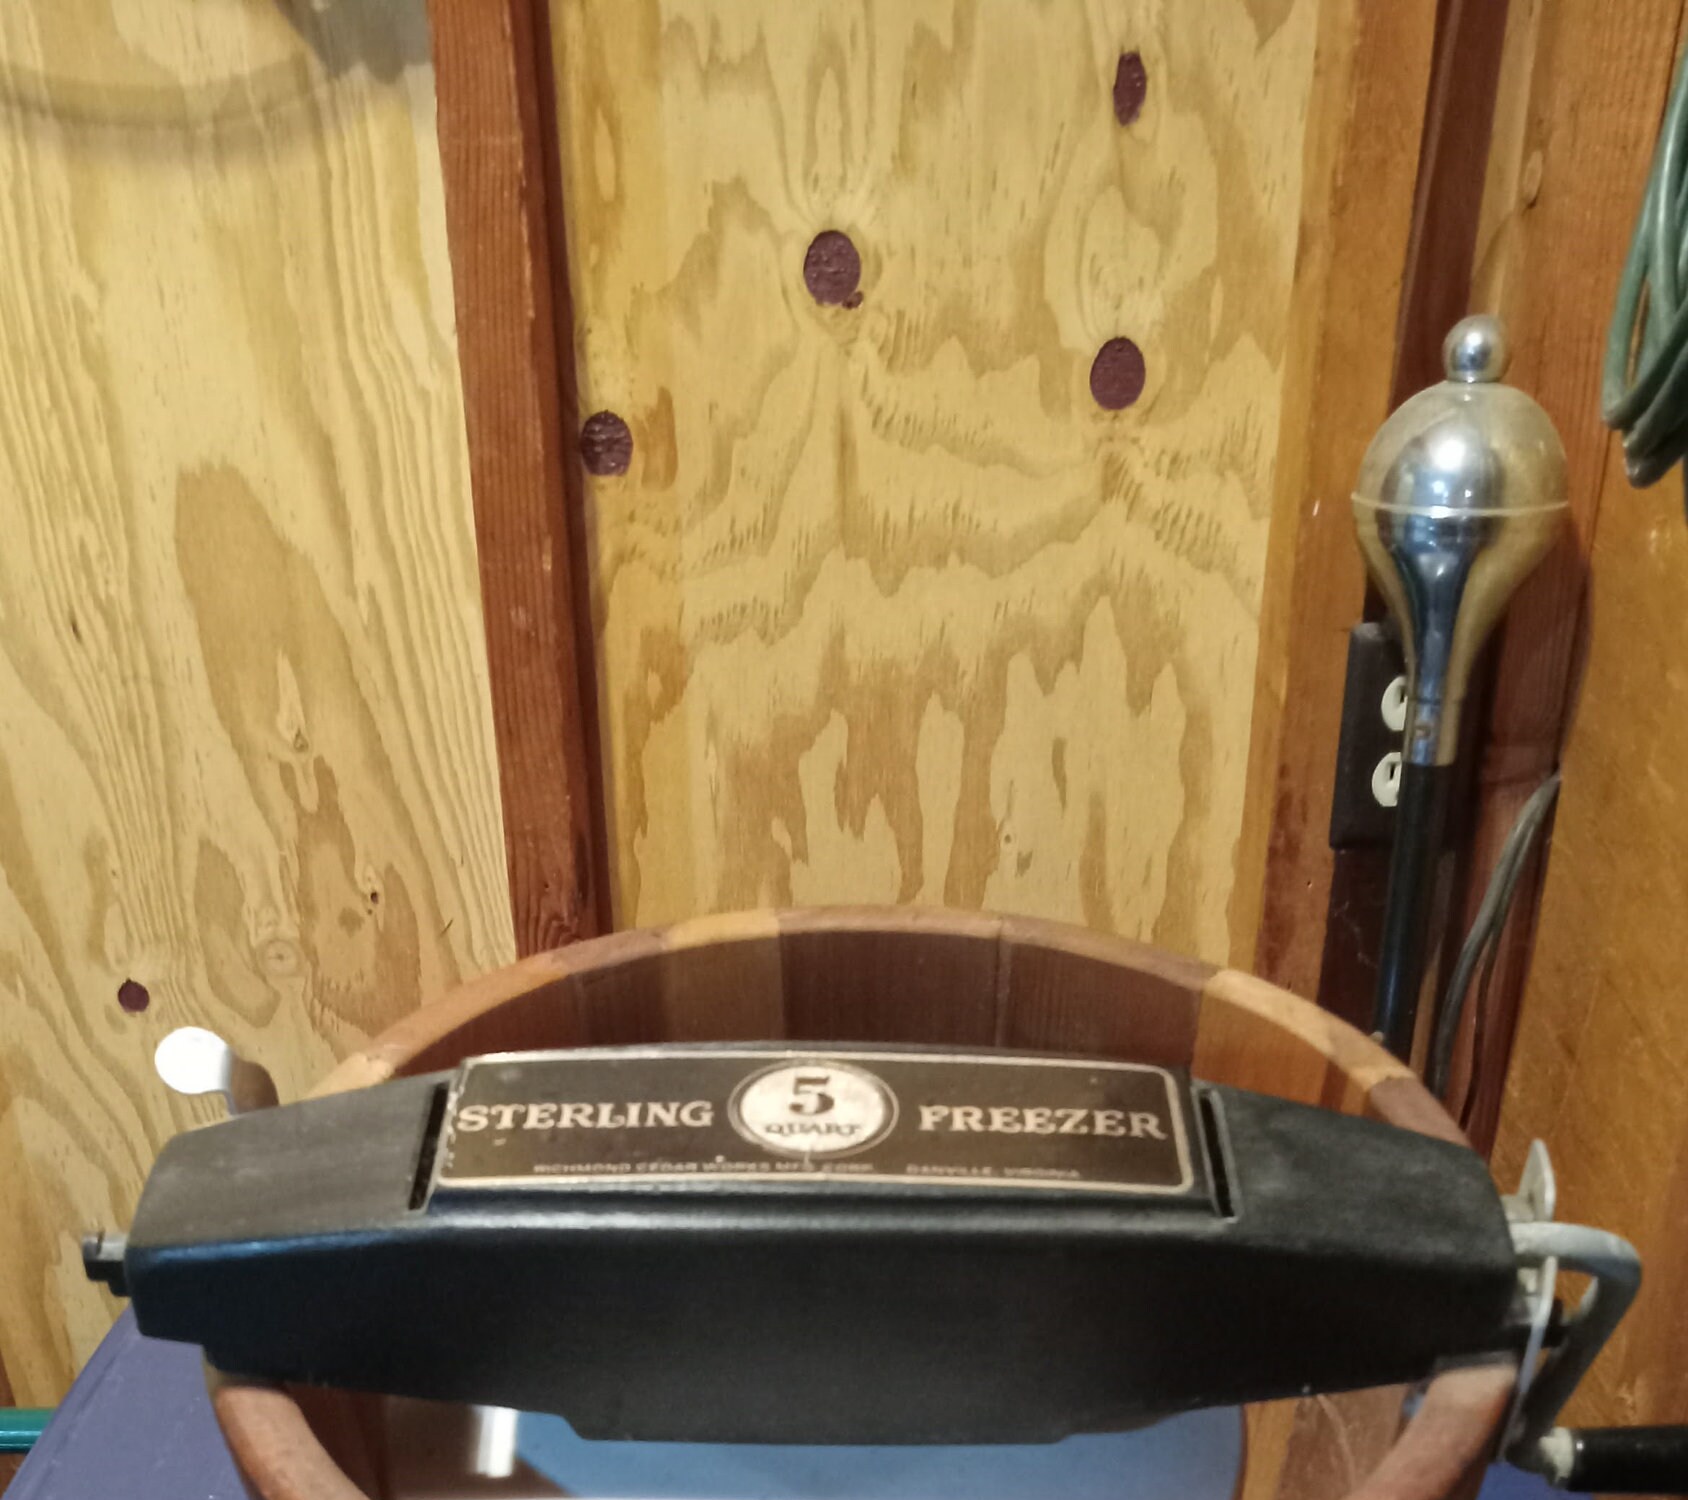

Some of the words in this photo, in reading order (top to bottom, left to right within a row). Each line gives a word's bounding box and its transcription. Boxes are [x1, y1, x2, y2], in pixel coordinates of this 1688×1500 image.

[788, 1075, 835, 1116] 5
[456, 1099, 715, 1133] STERLING
[765, 1122, 862, 1136] QUART
[918, 1104, 1169, 1141] FREEZER
